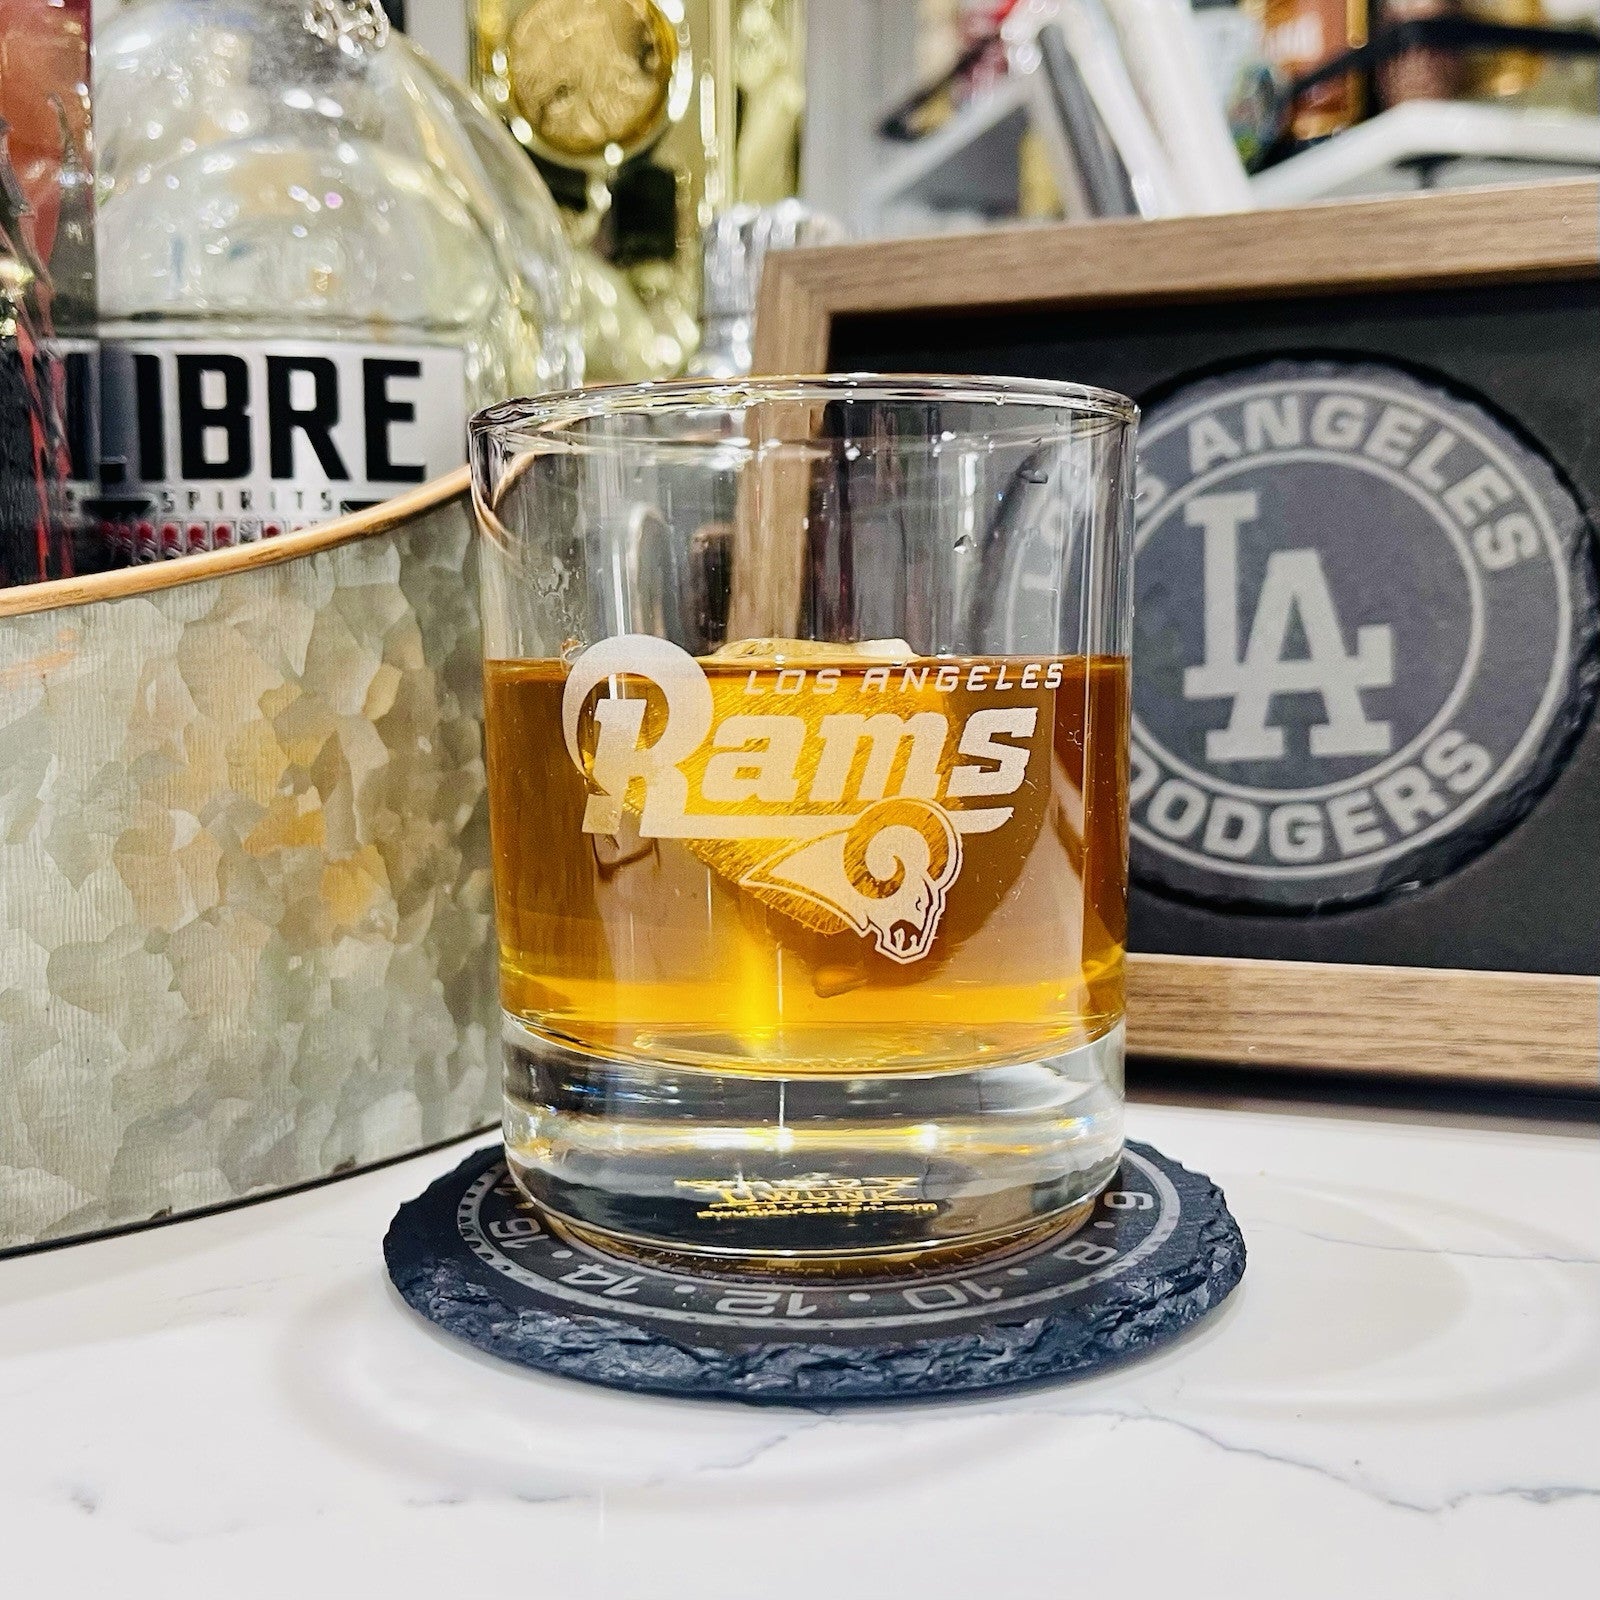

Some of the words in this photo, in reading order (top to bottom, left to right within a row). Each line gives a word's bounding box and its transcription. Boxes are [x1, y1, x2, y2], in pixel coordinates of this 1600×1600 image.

[1187, 397, 1541, 571] ANGELES
[1183, 491, 1393, 762] LA
[744, 668, 842, 696] LOS
[859, 662, 1064, 694] ANGELES
[562, 634, 1039, 838] Rams
[488, 1218, 550, 1249] 16
[1052, 1240, 1118, 1265] 8
[558, 1262, 646, 1297] 14
[902, 1279, 1004, 1311] 10
[714, 1288, 818, 1317] 12
